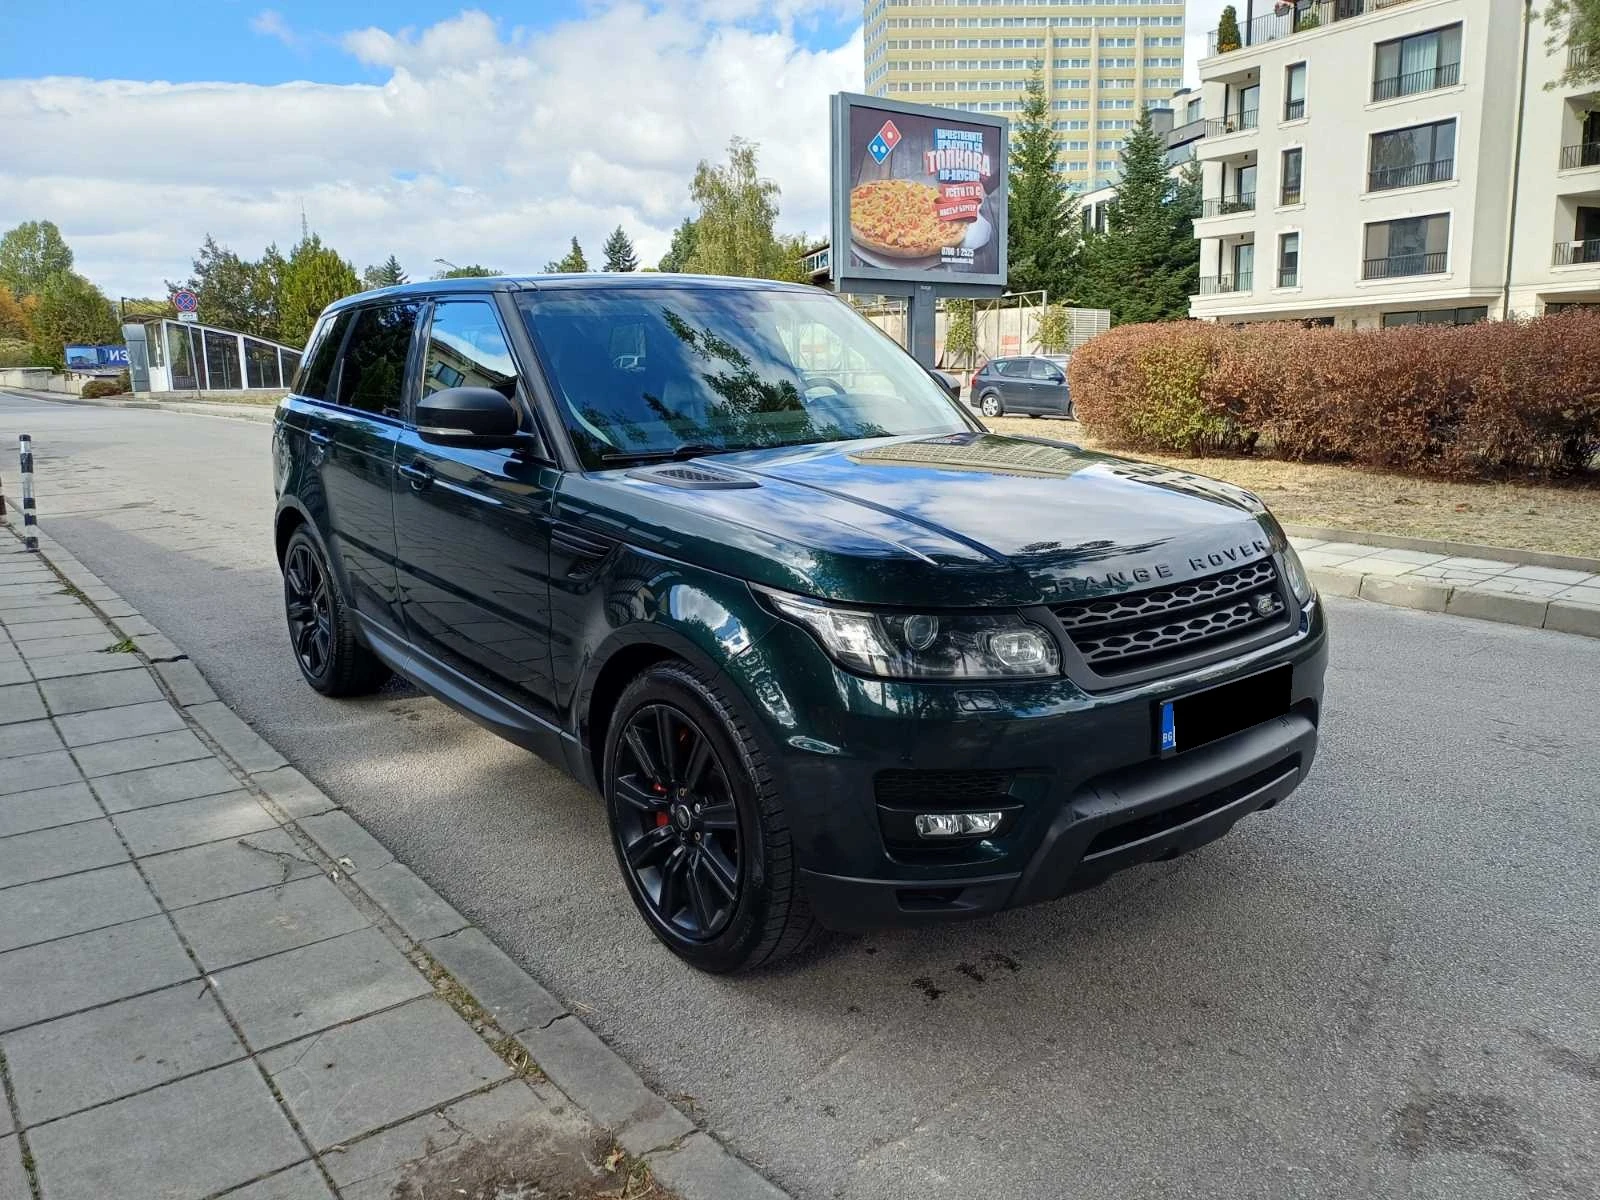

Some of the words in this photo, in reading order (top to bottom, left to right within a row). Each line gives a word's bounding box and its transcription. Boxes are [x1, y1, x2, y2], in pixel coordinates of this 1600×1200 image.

[1054, 562, 1174, 594] RANGE
[1188, 539, 1267, 572] ROVER
[1162, 731, 1174, 744] BG
